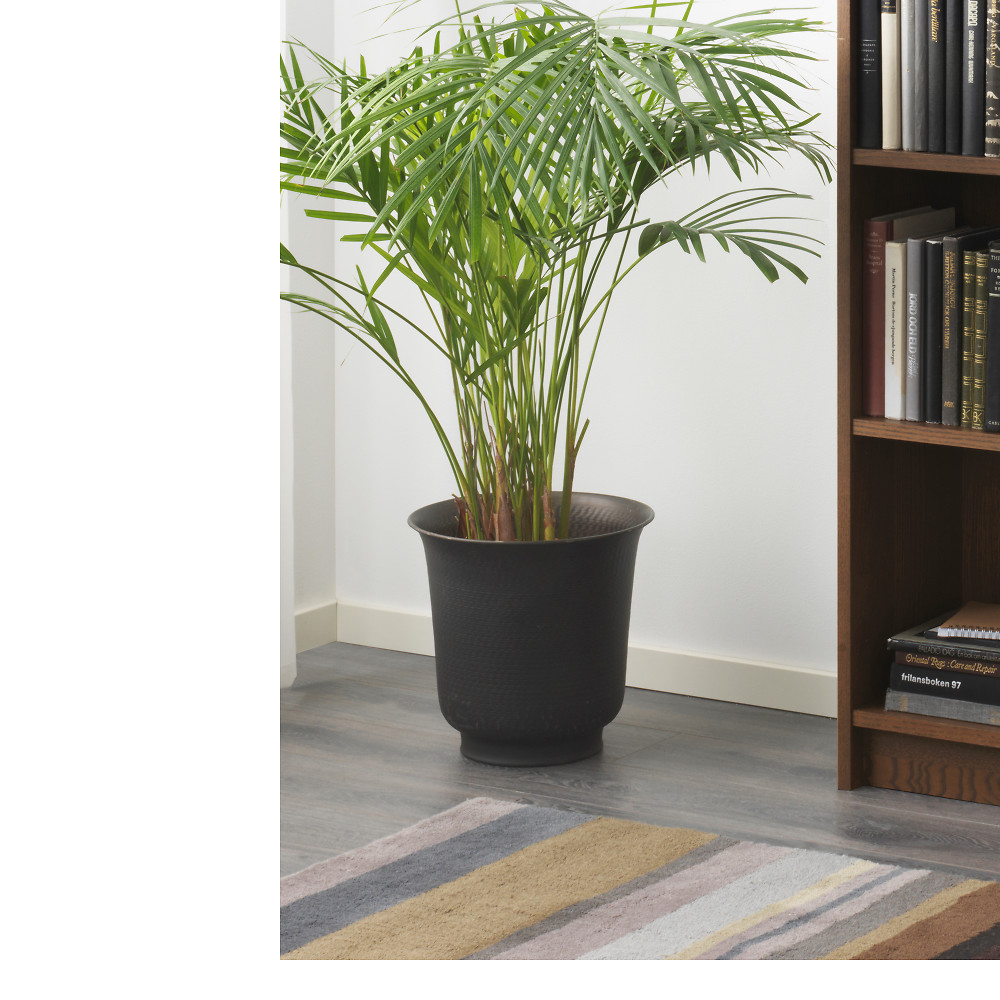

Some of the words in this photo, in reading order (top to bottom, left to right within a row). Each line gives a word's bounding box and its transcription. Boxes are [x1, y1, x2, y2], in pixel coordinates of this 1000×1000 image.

[967, 0, 978, 26] DACAPO
[908, 292, 918, 315] JORD
[908, 316, 918, 335] OCH
[908, 337, 918, 354] ELD
[906, 653, 930, 665] Oriental
[931, 657, 946, 670] Rugs
[949, 659, 964, 669] Care
[964, 663, 976, 672] and
[976, 665, 998, 674] Repair
[901, 672, 950, 688] frilansboken
[951, 680, 961, 689] 97
